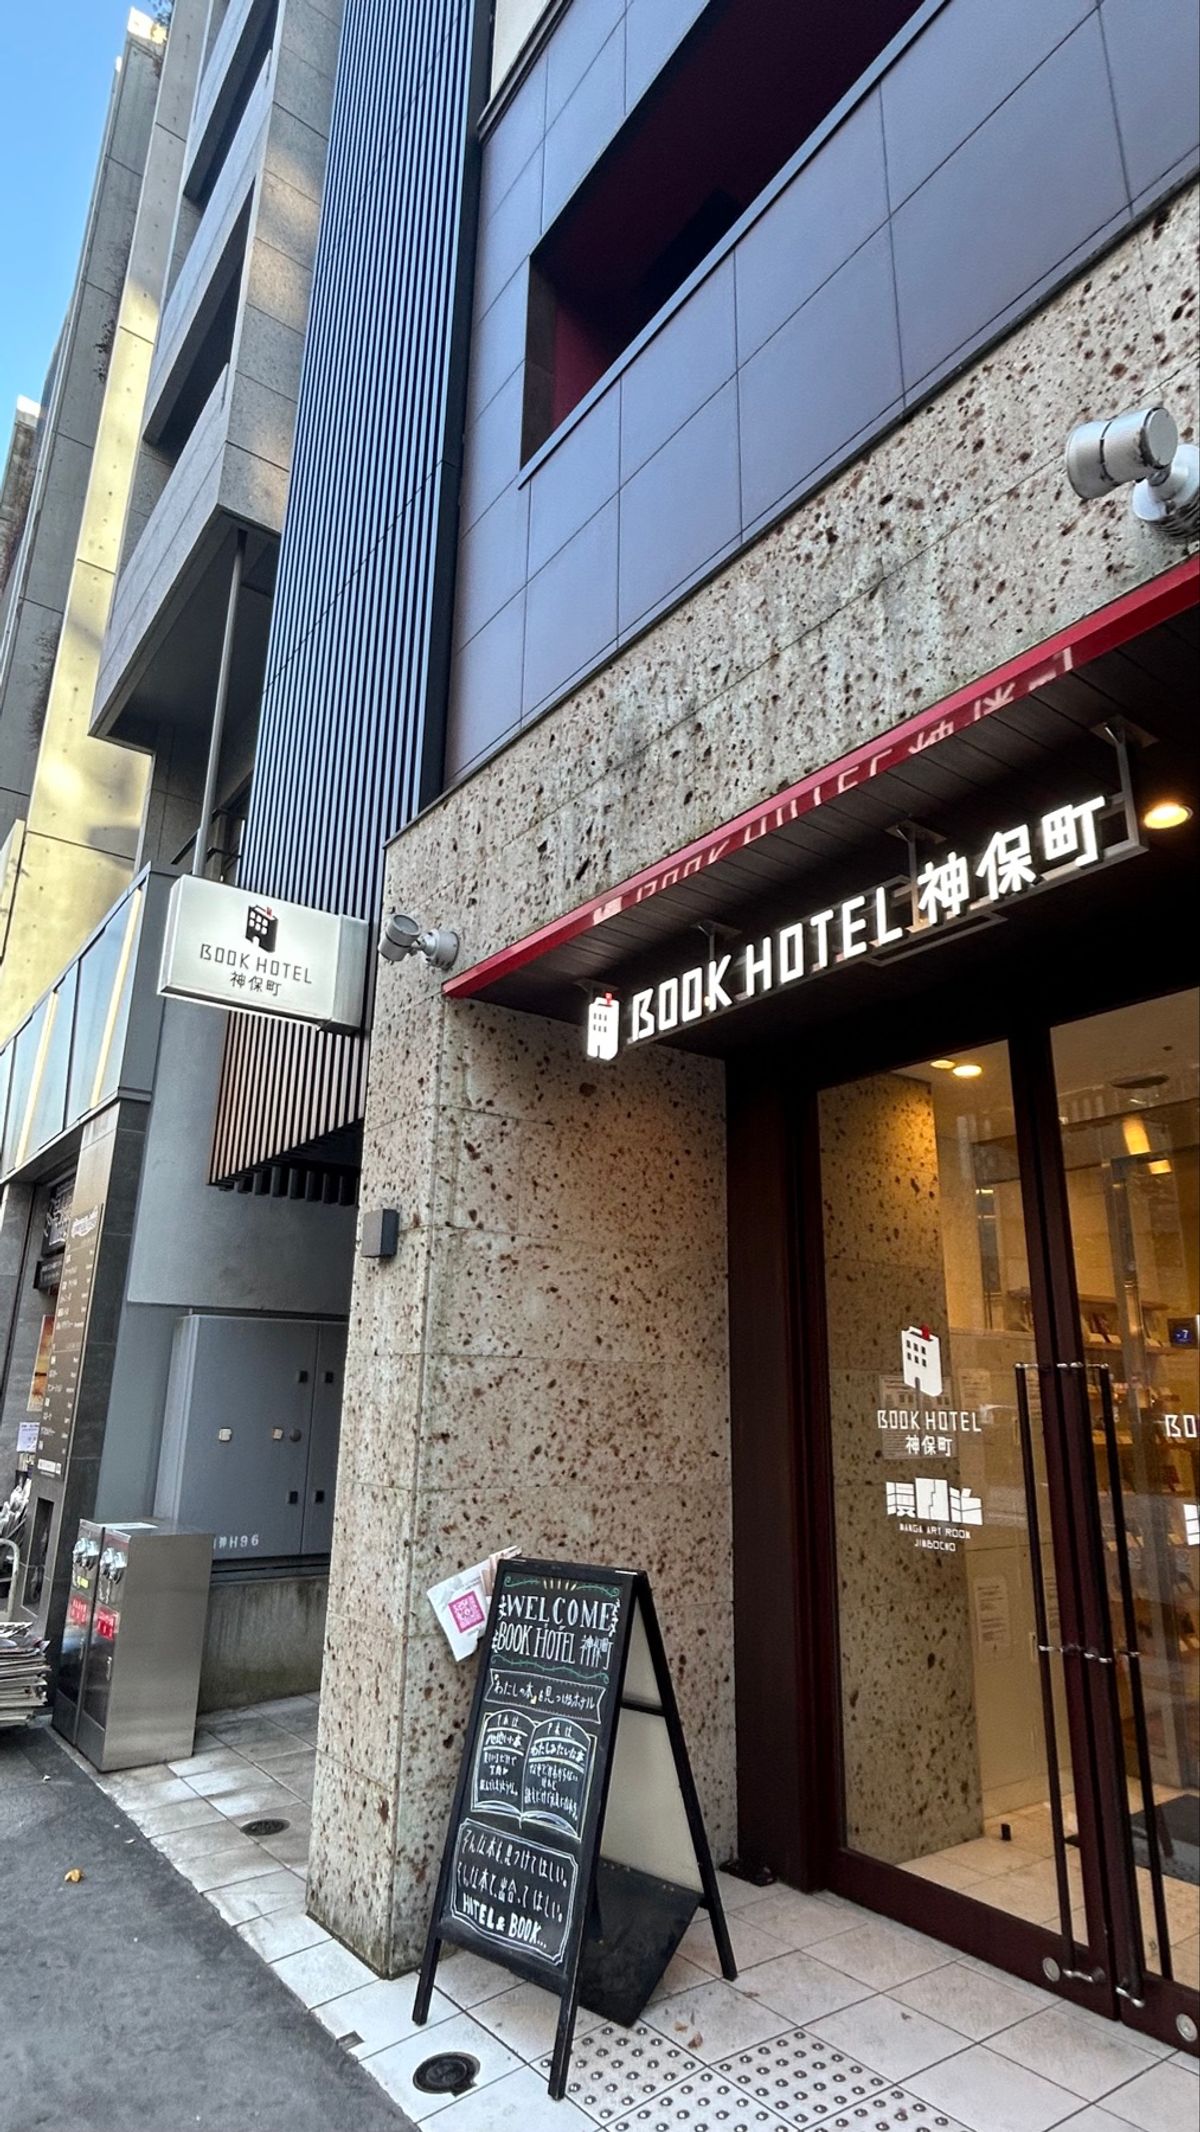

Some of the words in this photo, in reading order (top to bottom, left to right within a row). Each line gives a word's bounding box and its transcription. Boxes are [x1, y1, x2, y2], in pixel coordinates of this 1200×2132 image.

[630, 954, 733, 1043] BOOK
[744, 886, 903, 998] HOTEL
[916, 794, 1107, 925] 神保町
[200, 943, 250, 970] BOOK
[256, 956, 312, 985] HOTEL
[230, 971, 282, 996] 神保町
[877, 1410, 920, 1430] BOOK
[925, 1411, 982, 1433] HOTEL
[905, 1434, 953, 1457] 神保町
[926, 1525, 942, 1536] ART
[945, 1528, 971, 1539] ROOM
[506, 1593, 613, 1631] WELCOME
[496, 1621, 533, 1656] BOOK
[533, 1623, 576, 1665] HOTEL
